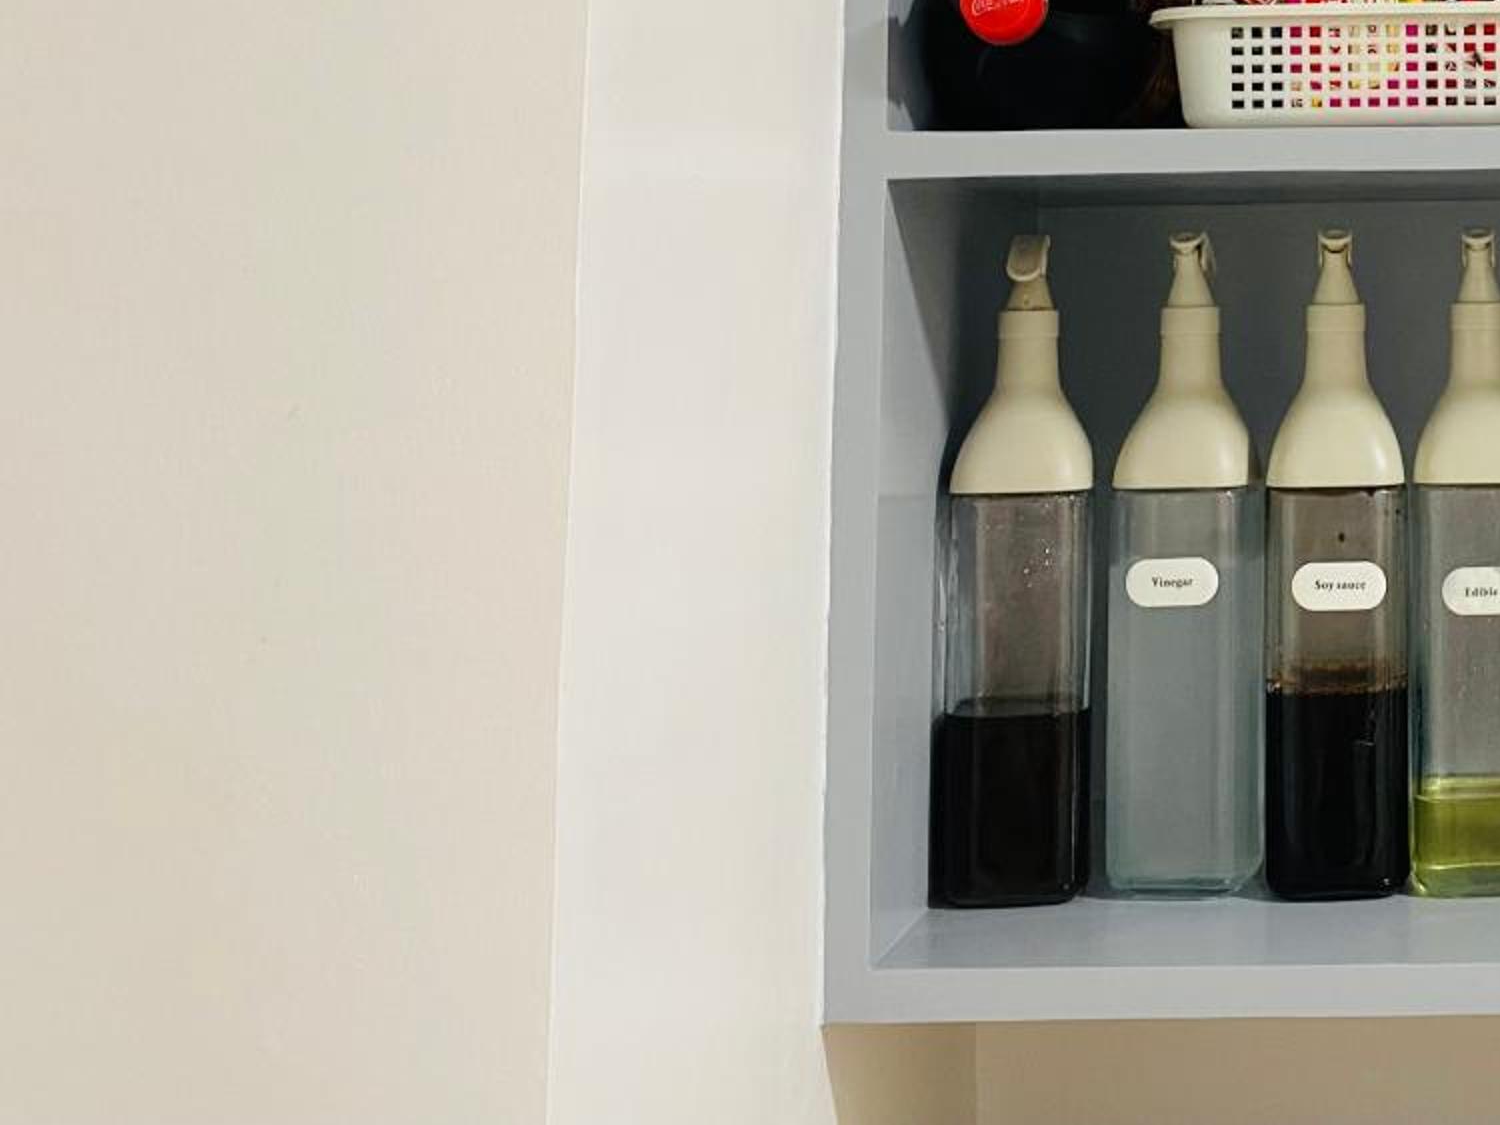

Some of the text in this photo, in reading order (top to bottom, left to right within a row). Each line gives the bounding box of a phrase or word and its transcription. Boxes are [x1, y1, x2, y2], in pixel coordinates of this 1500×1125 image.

[1151, 576, 1193, 589] Vinegar
[1314, 579, 1366, 592] Soy sauce
